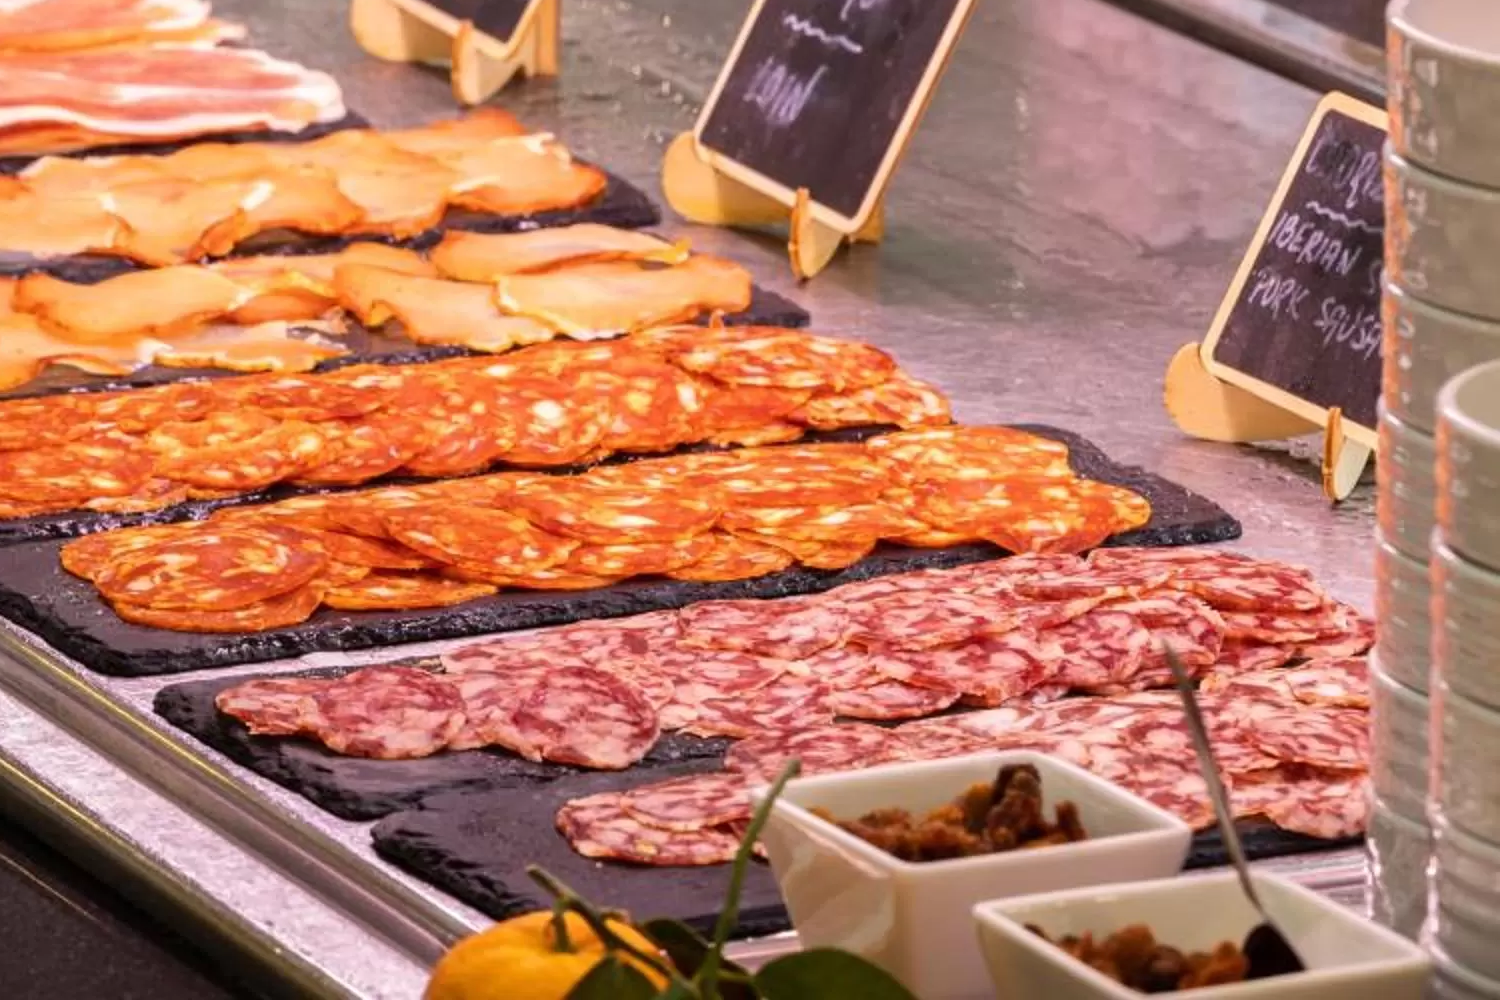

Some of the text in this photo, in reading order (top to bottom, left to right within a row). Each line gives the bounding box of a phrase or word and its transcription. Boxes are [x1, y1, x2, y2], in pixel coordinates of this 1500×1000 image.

[1267, 209, 1363, 277] IBERIAN
[1247, 267, 1311, 321] PORK
[1313, 295, 1383, 362] SAUSA
